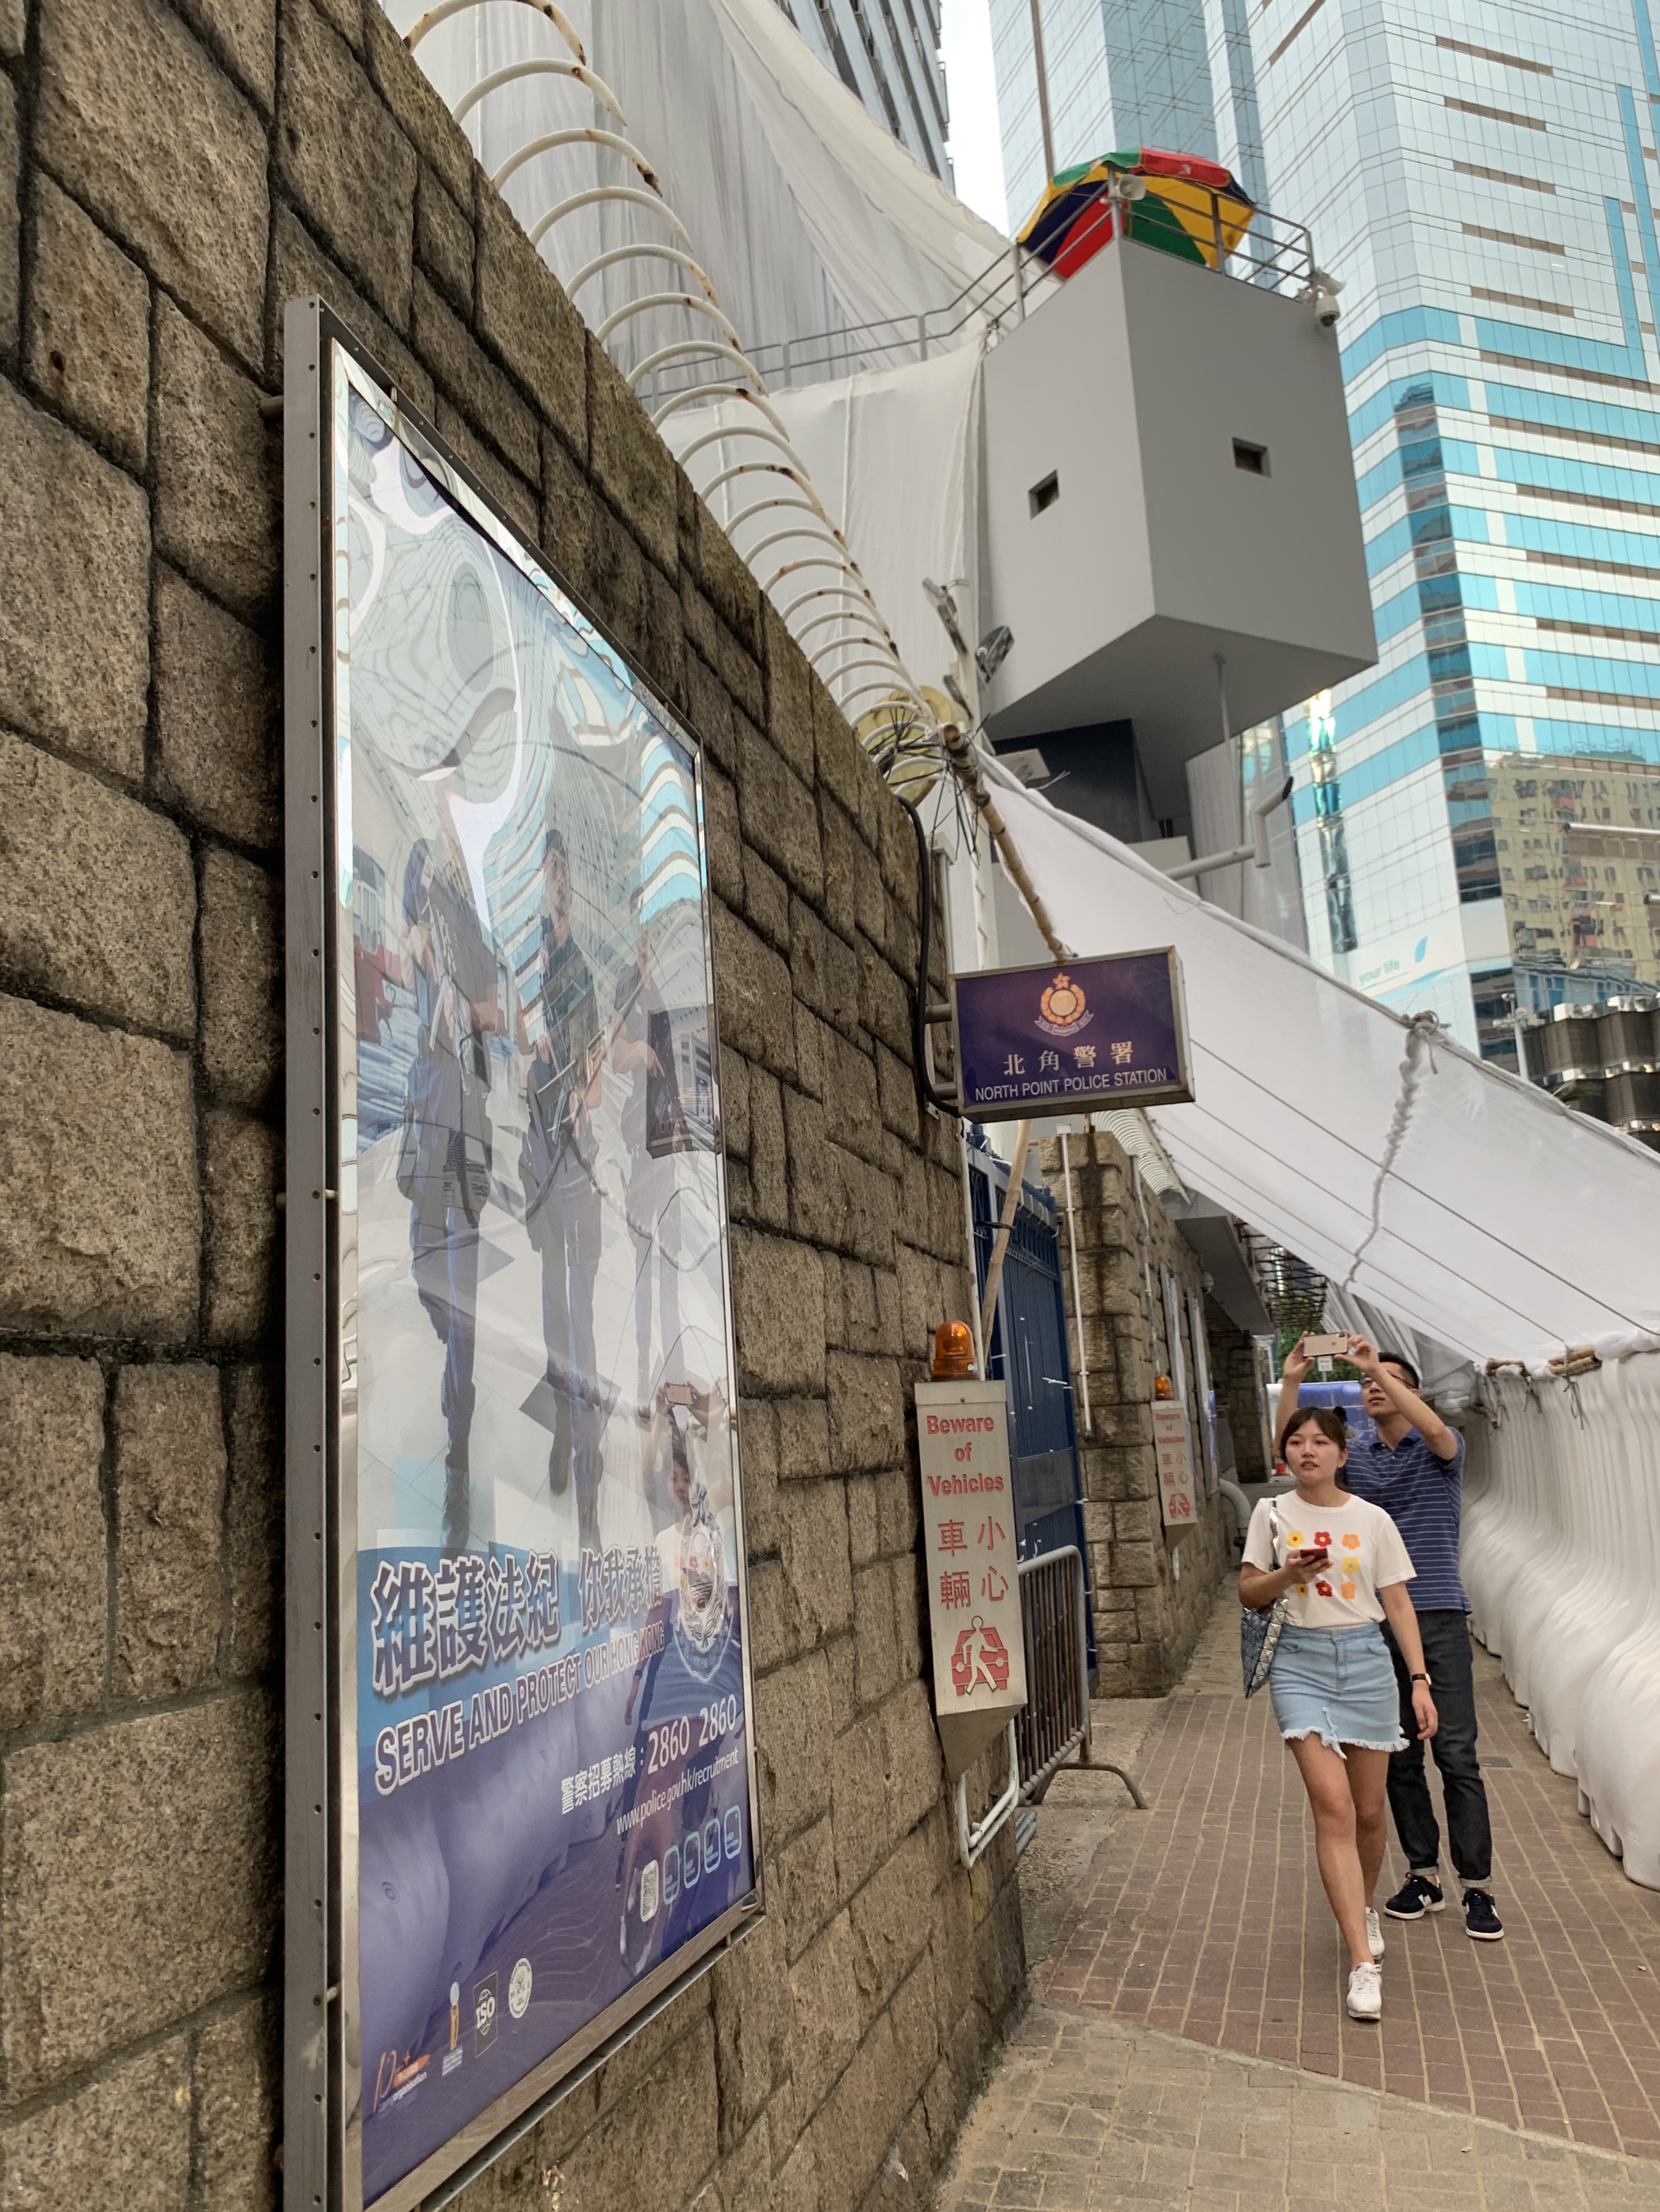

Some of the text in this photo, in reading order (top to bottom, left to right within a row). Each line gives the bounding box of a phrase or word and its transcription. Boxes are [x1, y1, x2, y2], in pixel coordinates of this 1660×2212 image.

[1359, 959, 1400, 986] your life
[1003, 1041, 1133, 1076] 北角警署
[976, 1068, 1167, 1101] NORTH POINT POLICE STATION
[926, 1415, 994, 1435] Beware
[954, 1442, 972, 1462] of
[928, 1473, 1004, 1496] Vehicles
[937, 1518, 971, 1610] 車輛
[977, 1516, 1009, 1602] 小心
[370, 1549, 560, 1696] 維護法紀
[375, 1700, 465, 1796] SERVE
[469, 1682, 513, 1750] AND
[516, 1652, 582, 1725] PROTECT
[584, 1642, 610, 1688] OUR
[610, 1630, 640, 1676] HONG
[639, 1620, 665, 1661] KONG
[648, 1716, 690, 1774] 2860
[699, 1693, 737, 1747] 2860
[617, 1746, 739, 1835] www.police.gov.hk/recruitment
[475, 1996, 496, 2029] ISO
